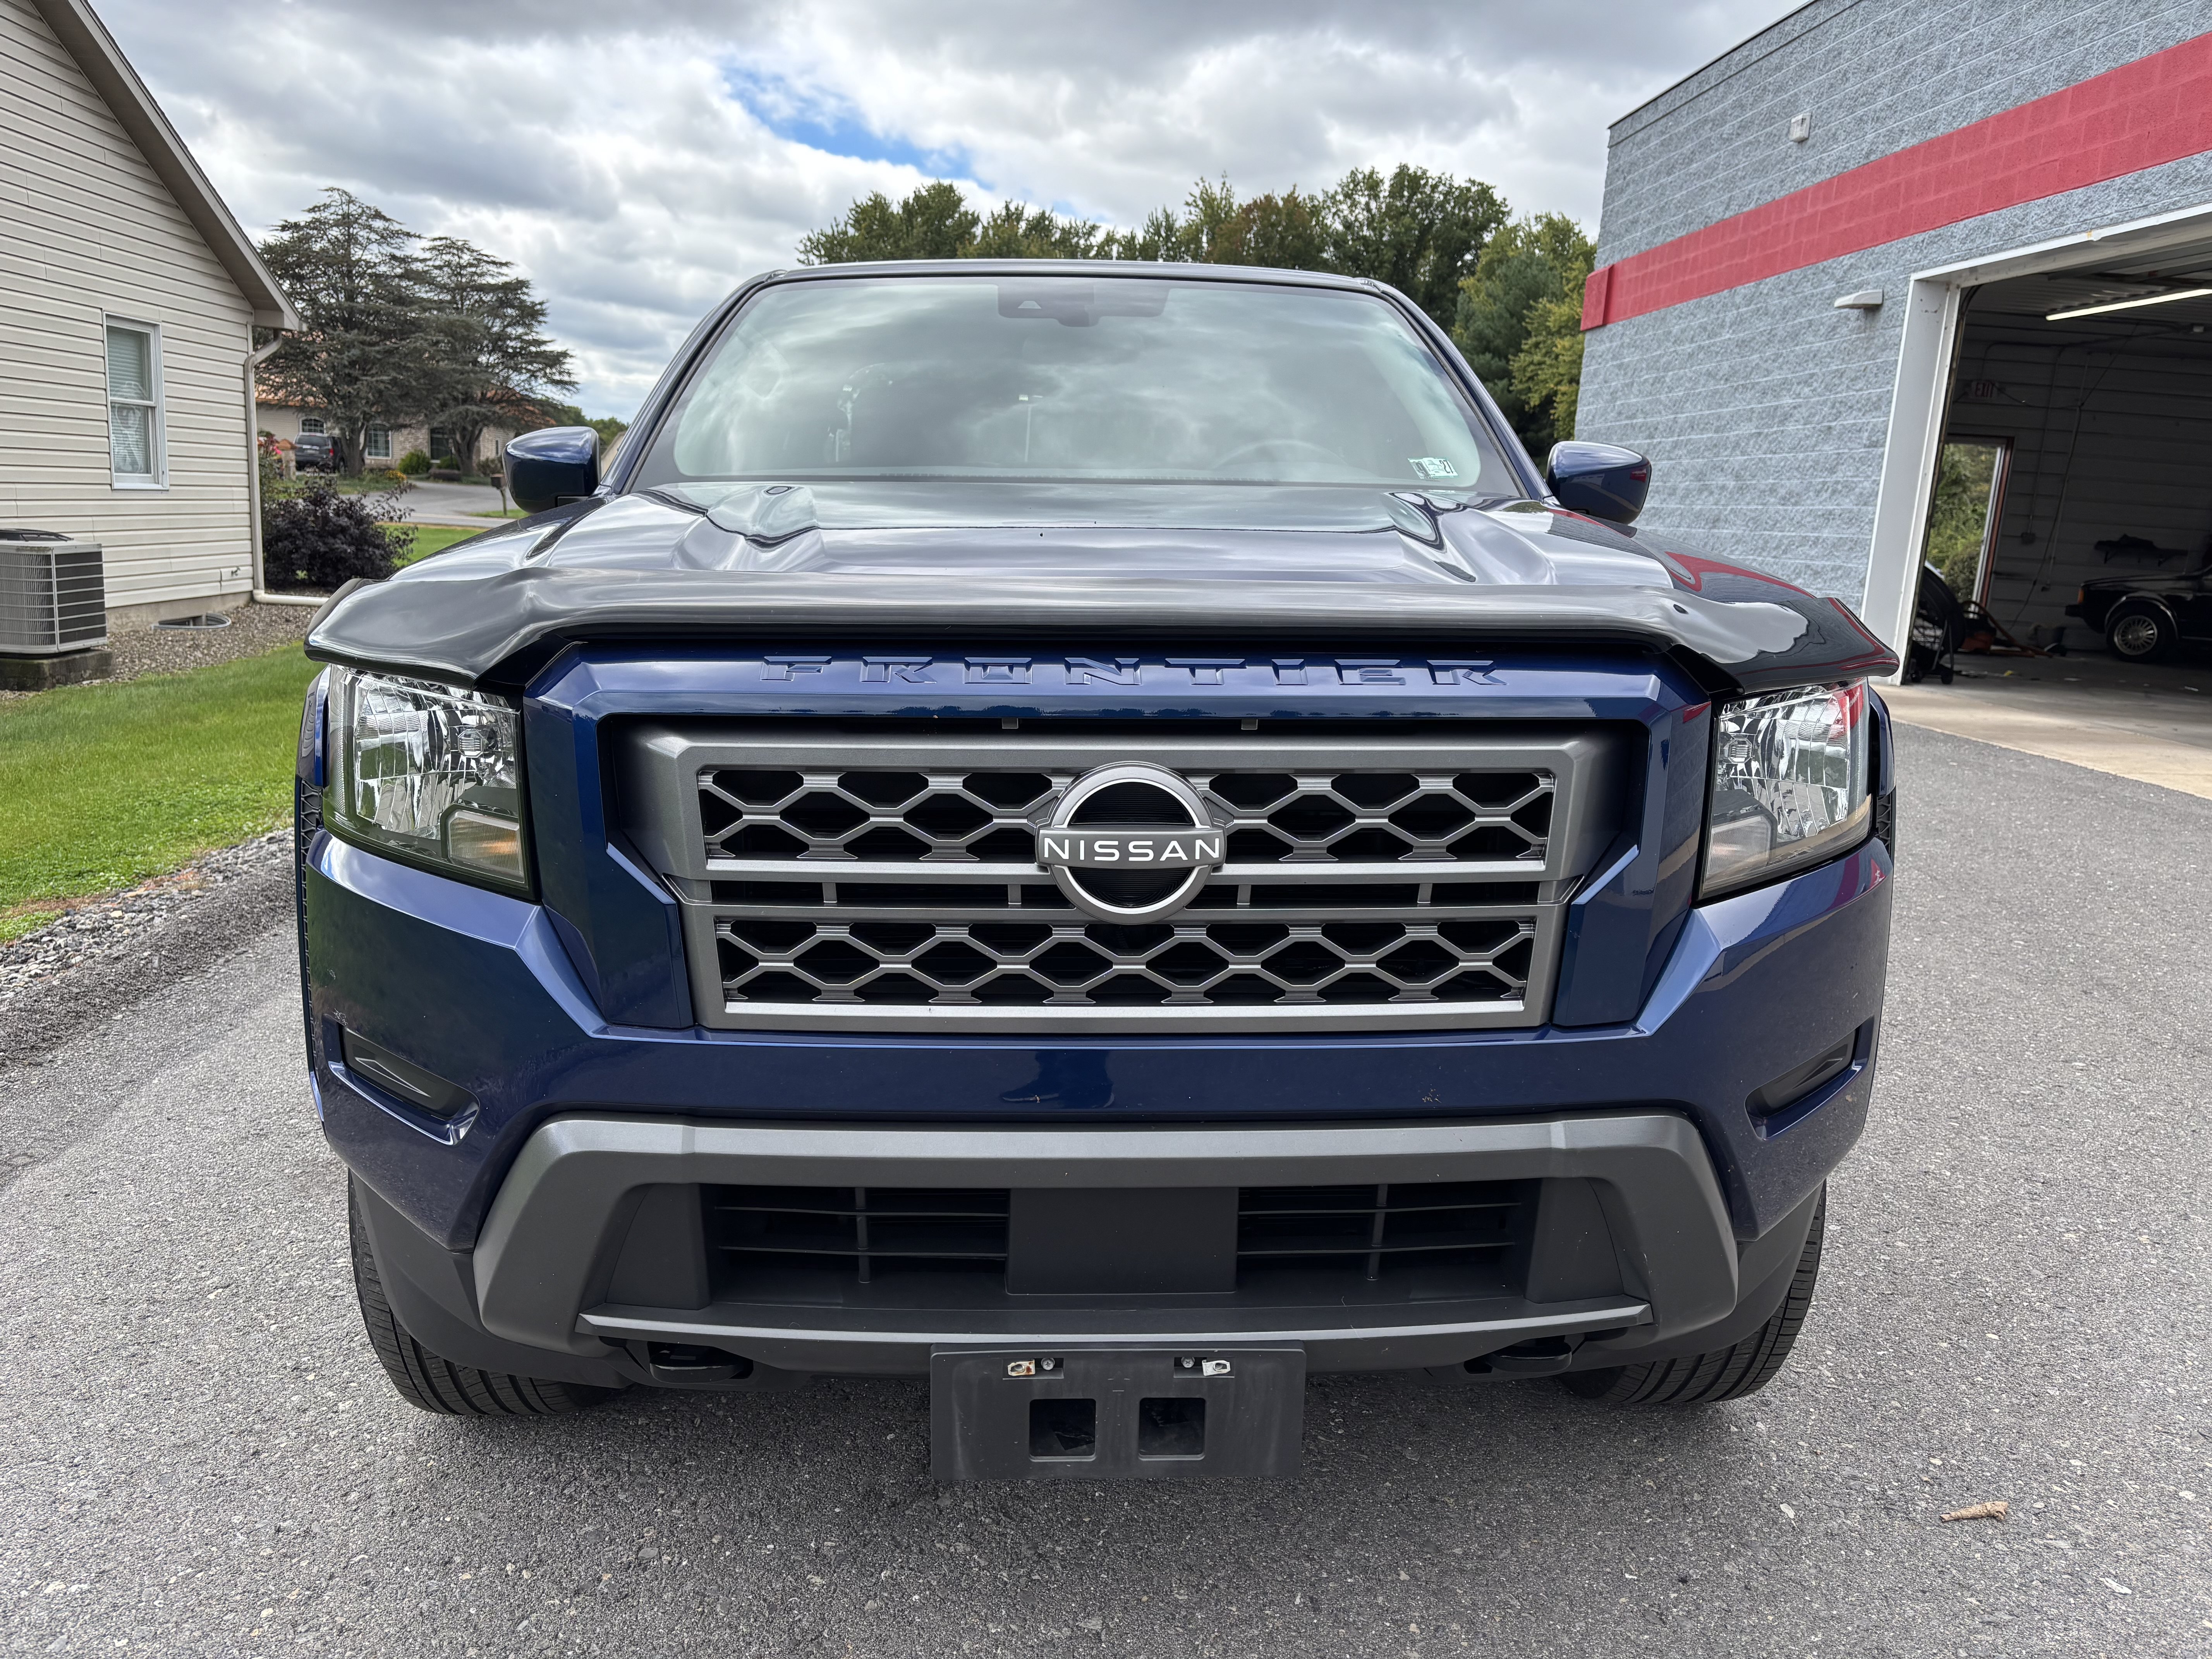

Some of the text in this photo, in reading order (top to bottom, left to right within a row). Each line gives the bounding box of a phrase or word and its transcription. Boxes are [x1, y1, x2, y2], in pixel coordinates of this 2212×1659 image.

[1975, 382, 1994, 398] EXIT
[1439, 460, 1453, 474] 27
[760, 656, 1508, 685] FRONTIER
[1044, 837, 1219, 861] NISSAN
